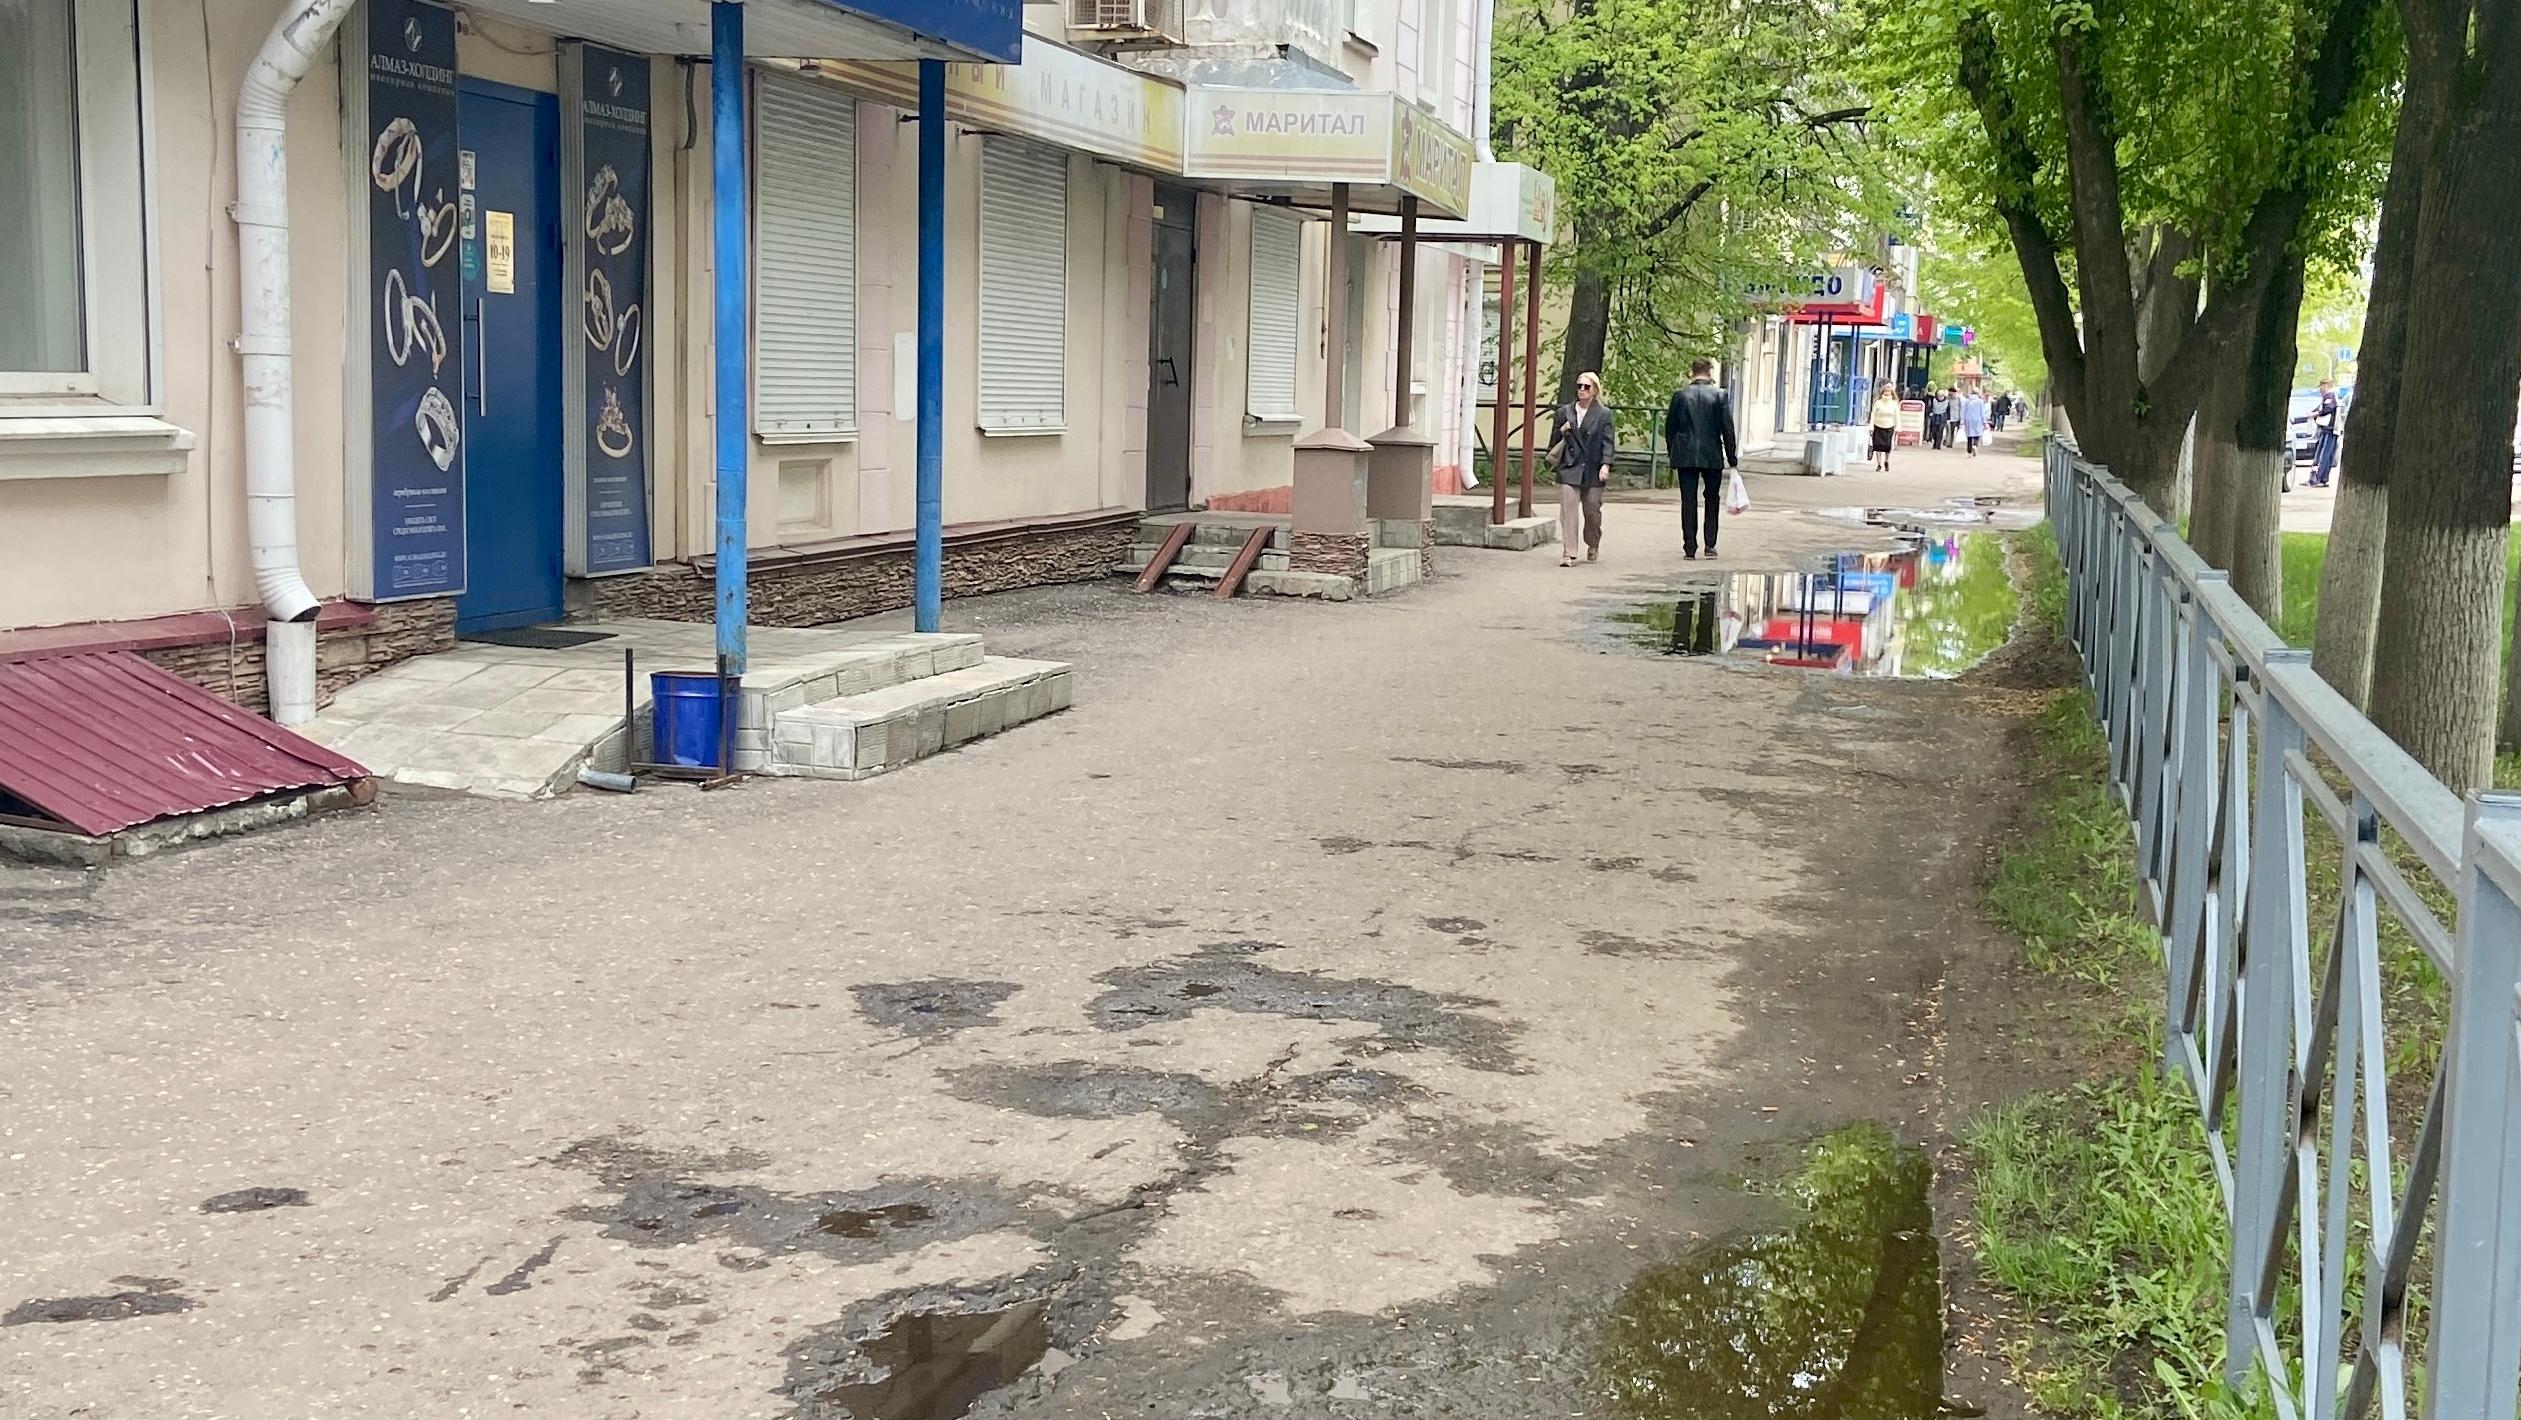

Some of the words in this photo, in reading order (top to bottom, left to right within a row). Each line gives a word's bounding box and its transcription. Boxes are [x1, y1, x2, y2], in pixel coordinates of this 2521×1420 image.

[370, 54, 455, 84] АЛМАЗ-ХОЛДИНГ
[1040, 71, 1151, 134] МАГАЗИН
[1245, 110, 1366, 136] МАРИТАЛ
[1415, 124, 1469, 199] МАРИТАЛ
[490, 244, 510, 263] 10-19
